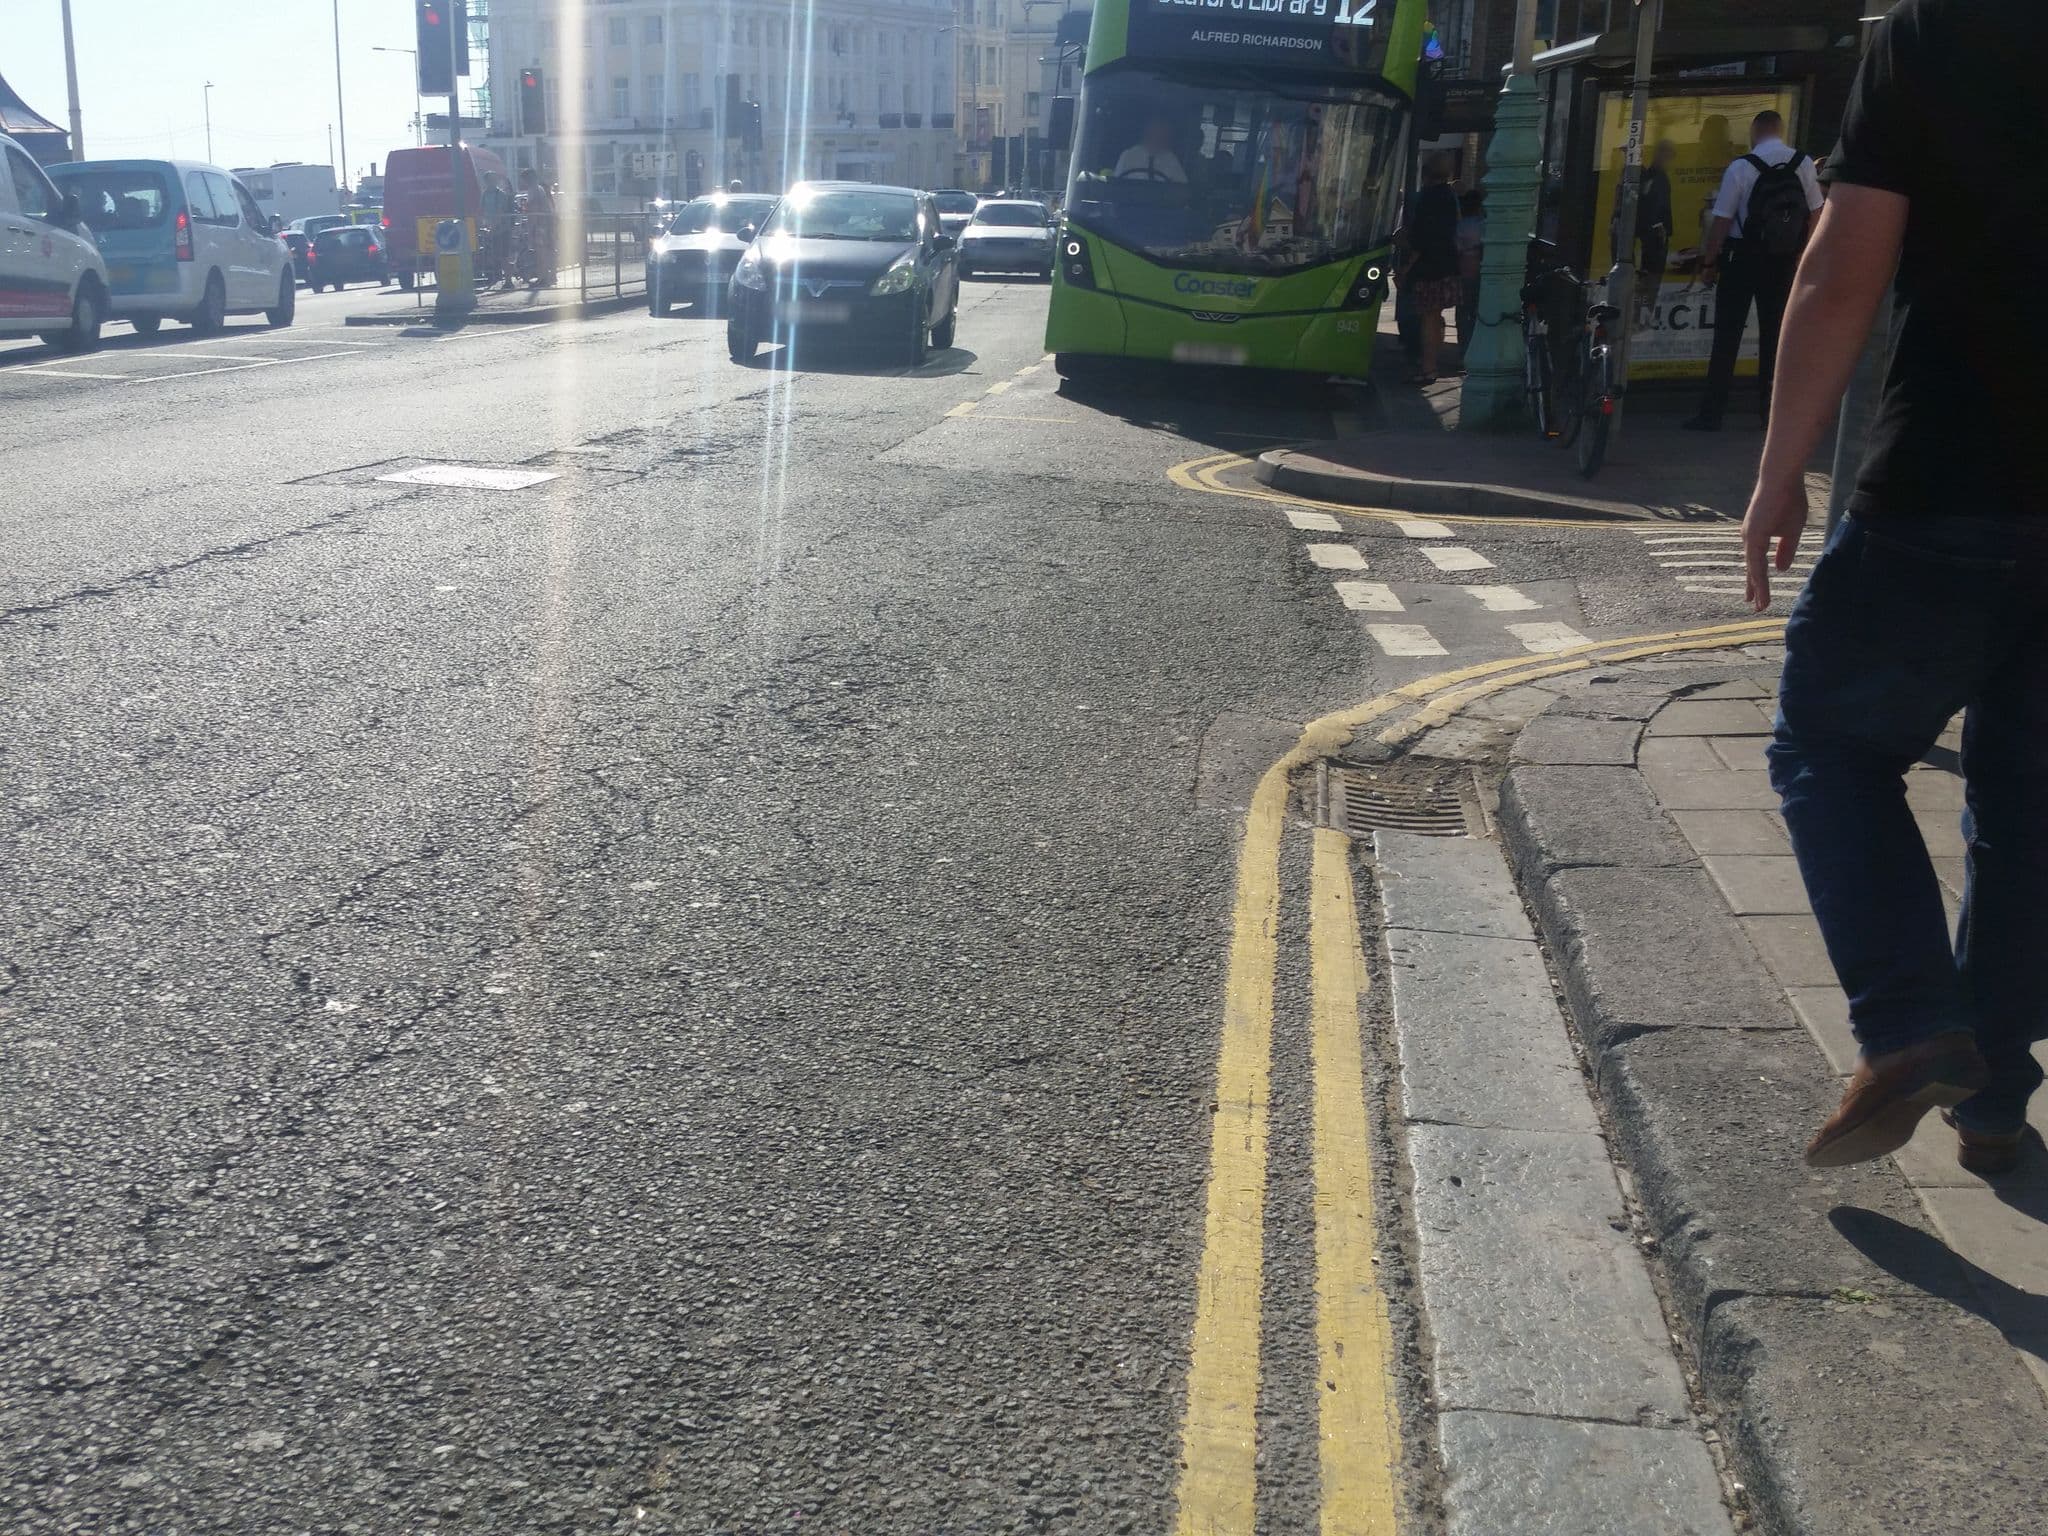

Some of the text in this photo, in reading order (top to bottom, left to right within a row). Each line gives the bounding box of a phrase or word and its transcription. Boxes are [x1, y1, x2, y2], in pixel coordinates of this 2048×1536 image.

[1333, 0, 1376, 25] 12
[1191, 30, 1323, 50] ALFRED RICHARDSON
[1173, 271, 1258, 298] Coaster
